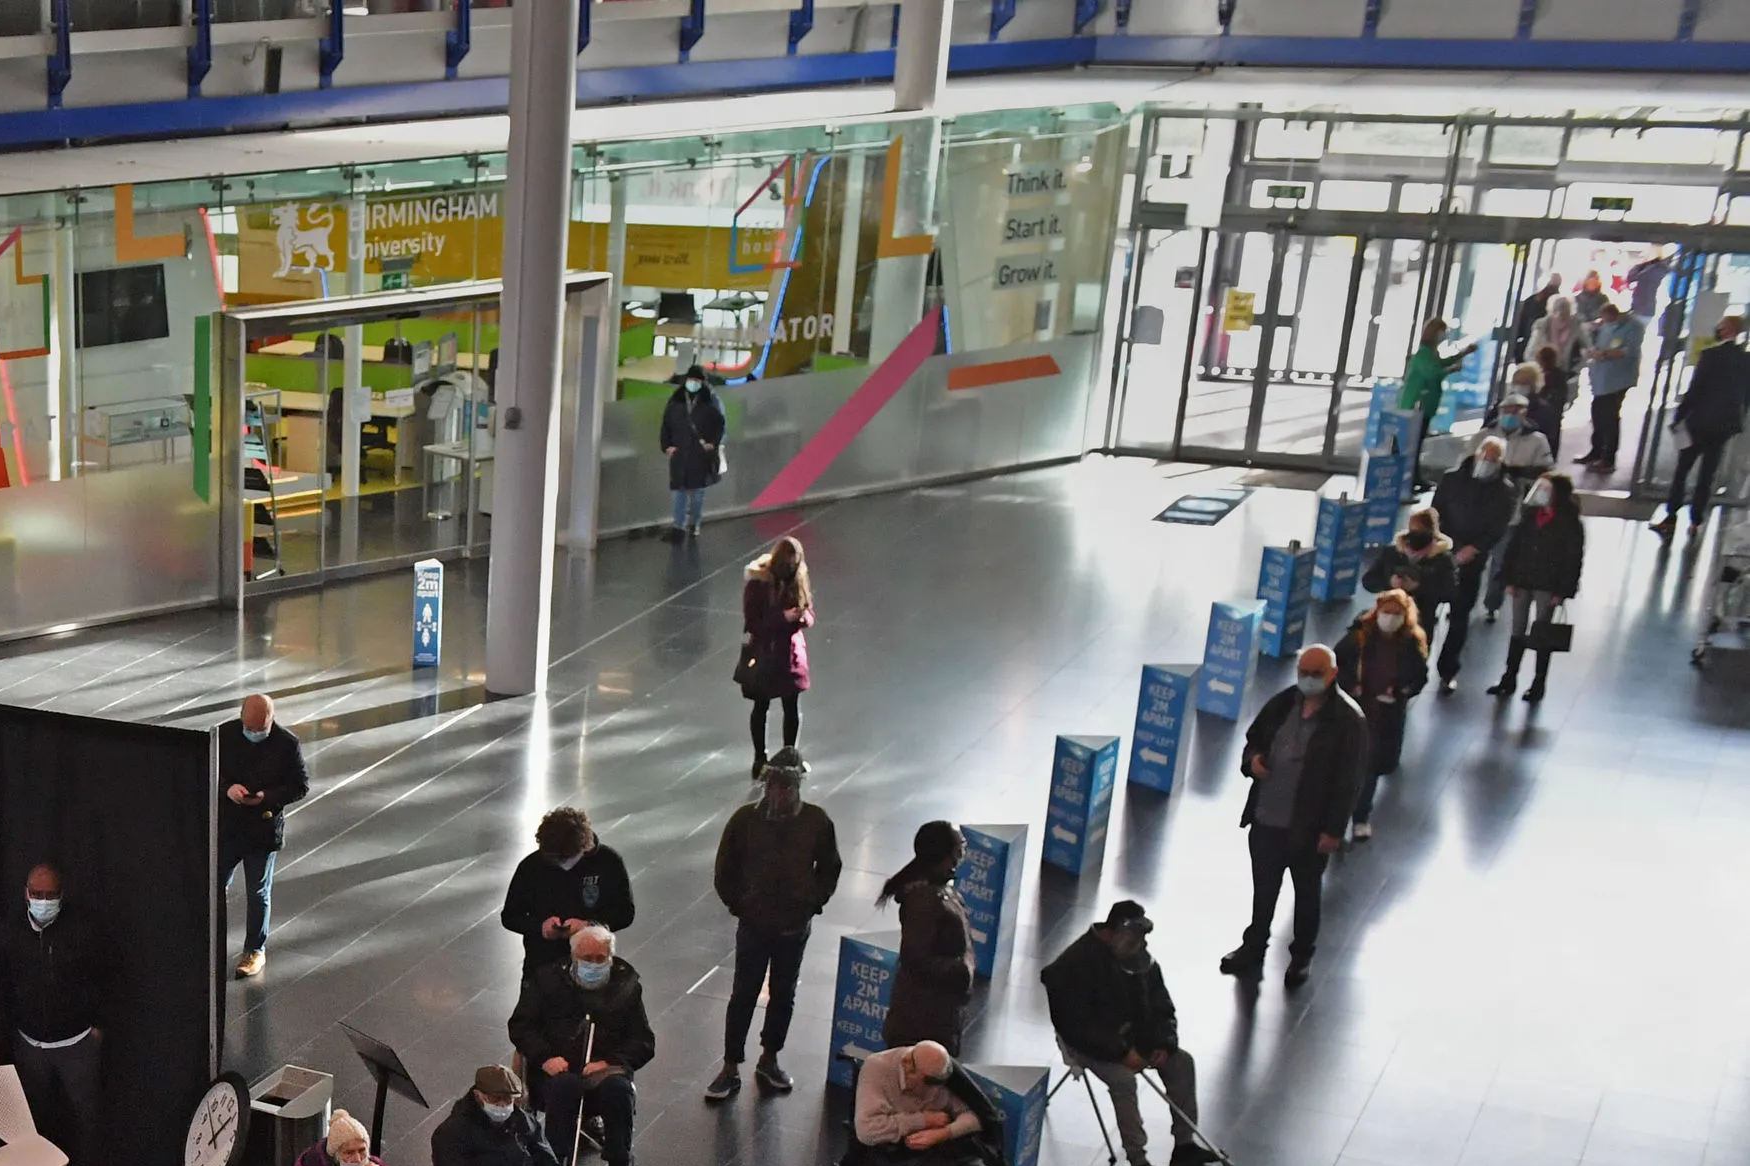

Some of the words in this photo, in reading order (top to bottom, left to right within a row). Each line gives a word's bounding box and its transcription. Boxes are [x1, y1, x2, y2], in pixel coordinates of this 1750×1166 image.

[1008, 170, 1049, 193] Think
[1052, 168, 1067, 189] it.
[349, 193, 498, 231] BIRMINGHAM
[1006, 218, 1045, 239] Start
[1048, 214, 1062, 235] it.
[348, 231, 445, 260] University
[999, 263, 1041, 285] Grow
[1043, 260, 1057, 279] it.
[417, 578, 439, 591] 2m
[1217, 620, 1244, 636] KEEP
[1149, 683, 1177, 700] KEEP
[1151, 698, 1171, 714] 2M
[1142, 711, 1176, 730] APART
[968, 865, 988, 884] 2M
[958, 879, 996, 901] APART
[851, 961, 890, 985] KEEP
[855, 981, 880, 999] 2M
[842, 994, 890, 1020] APART
[836, 1019, 863, 1037] KEEP
